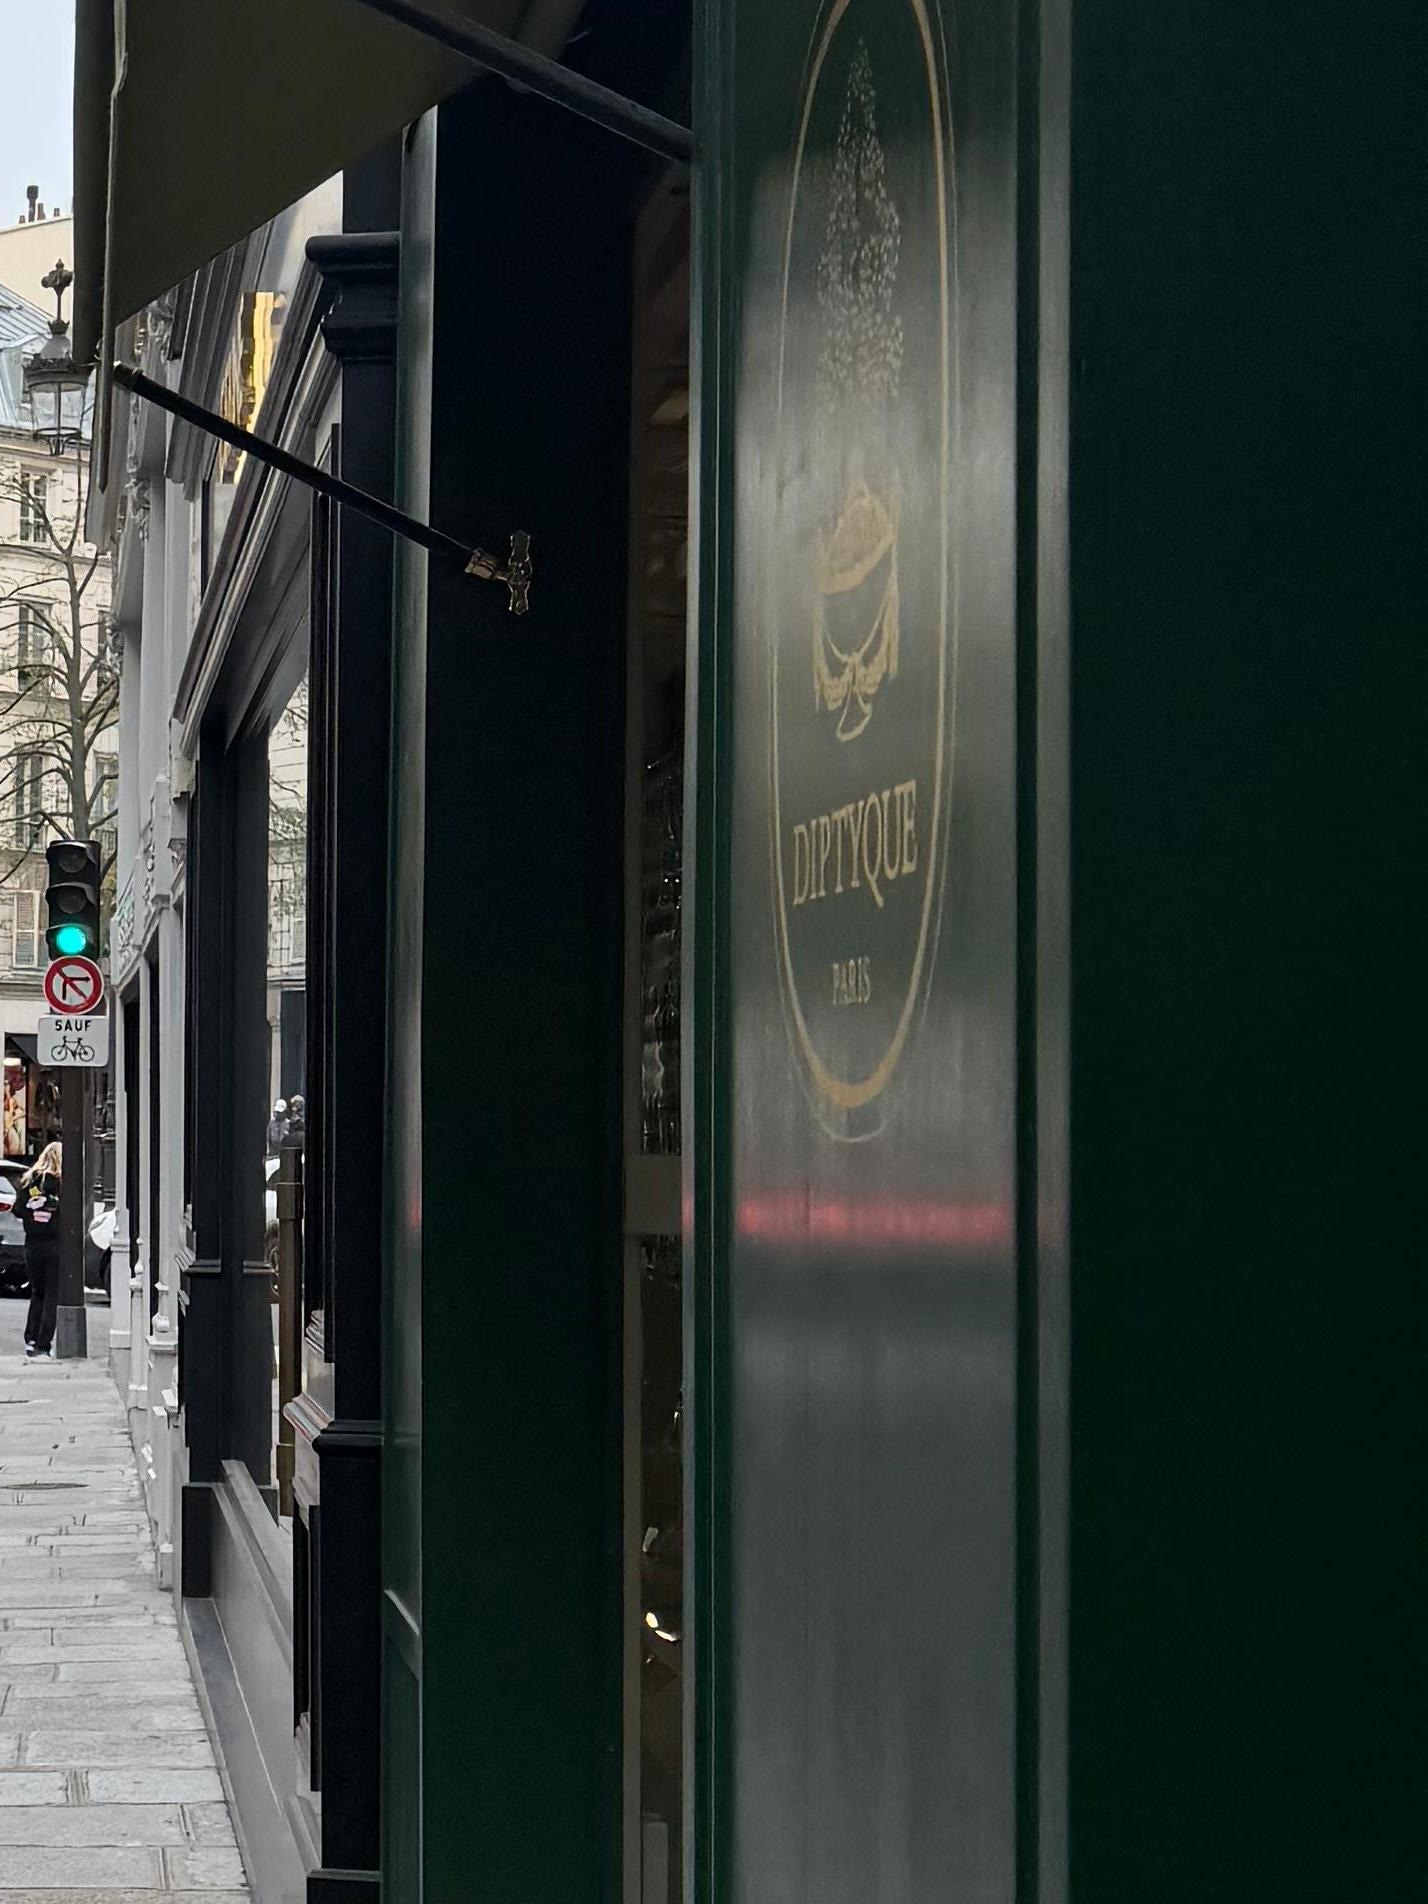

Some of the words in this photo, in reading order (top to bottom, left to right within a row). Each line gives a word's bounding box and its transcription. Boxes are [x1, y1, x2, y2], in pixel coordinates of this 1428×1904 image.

[794, 780, 918, 908] DIPTYQUE
[832, 955, 871, 1005] PARIS
[55, 1019, 91, 1032] SAUF
